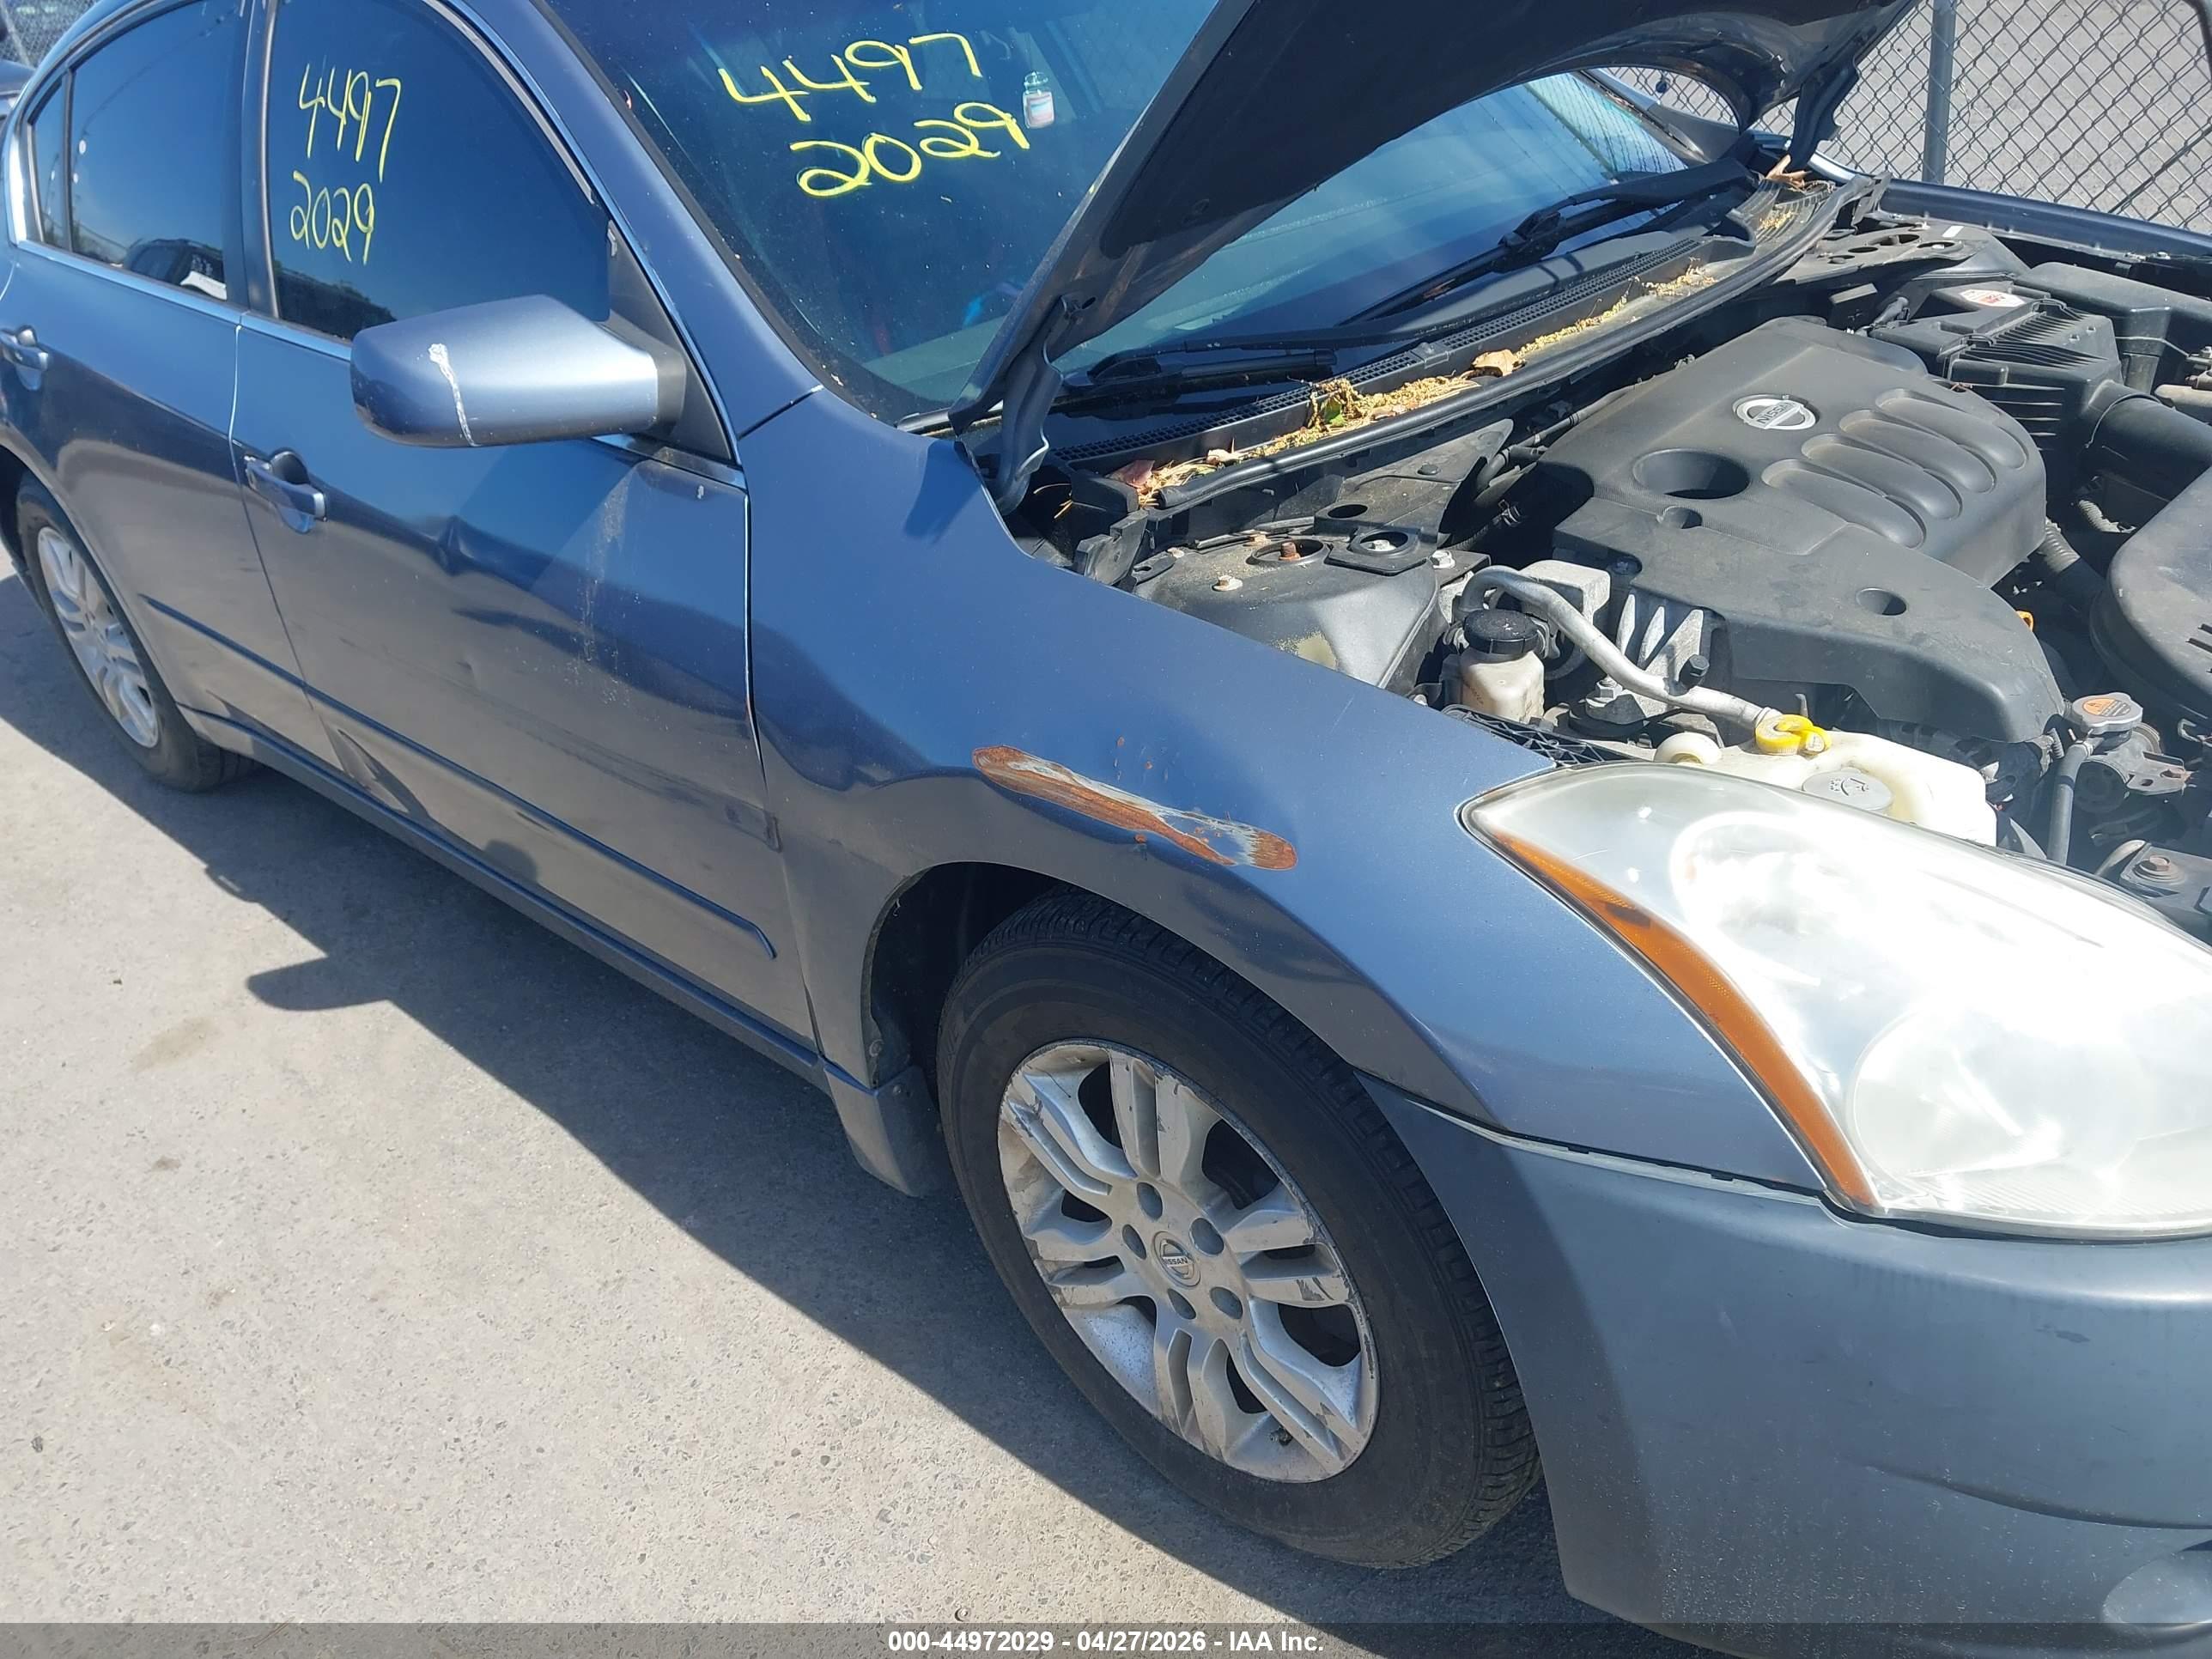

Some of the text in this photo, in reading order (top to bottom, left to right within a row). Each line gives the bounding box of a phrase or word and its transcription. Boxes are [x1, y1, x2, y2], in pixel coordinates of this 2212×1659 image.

[297, 63, 402, 182] 4497
[718, 33, 982, 123] 4497
[789, 101, 1031, 198] 2029
[289, 169, 375, 266] 2029
